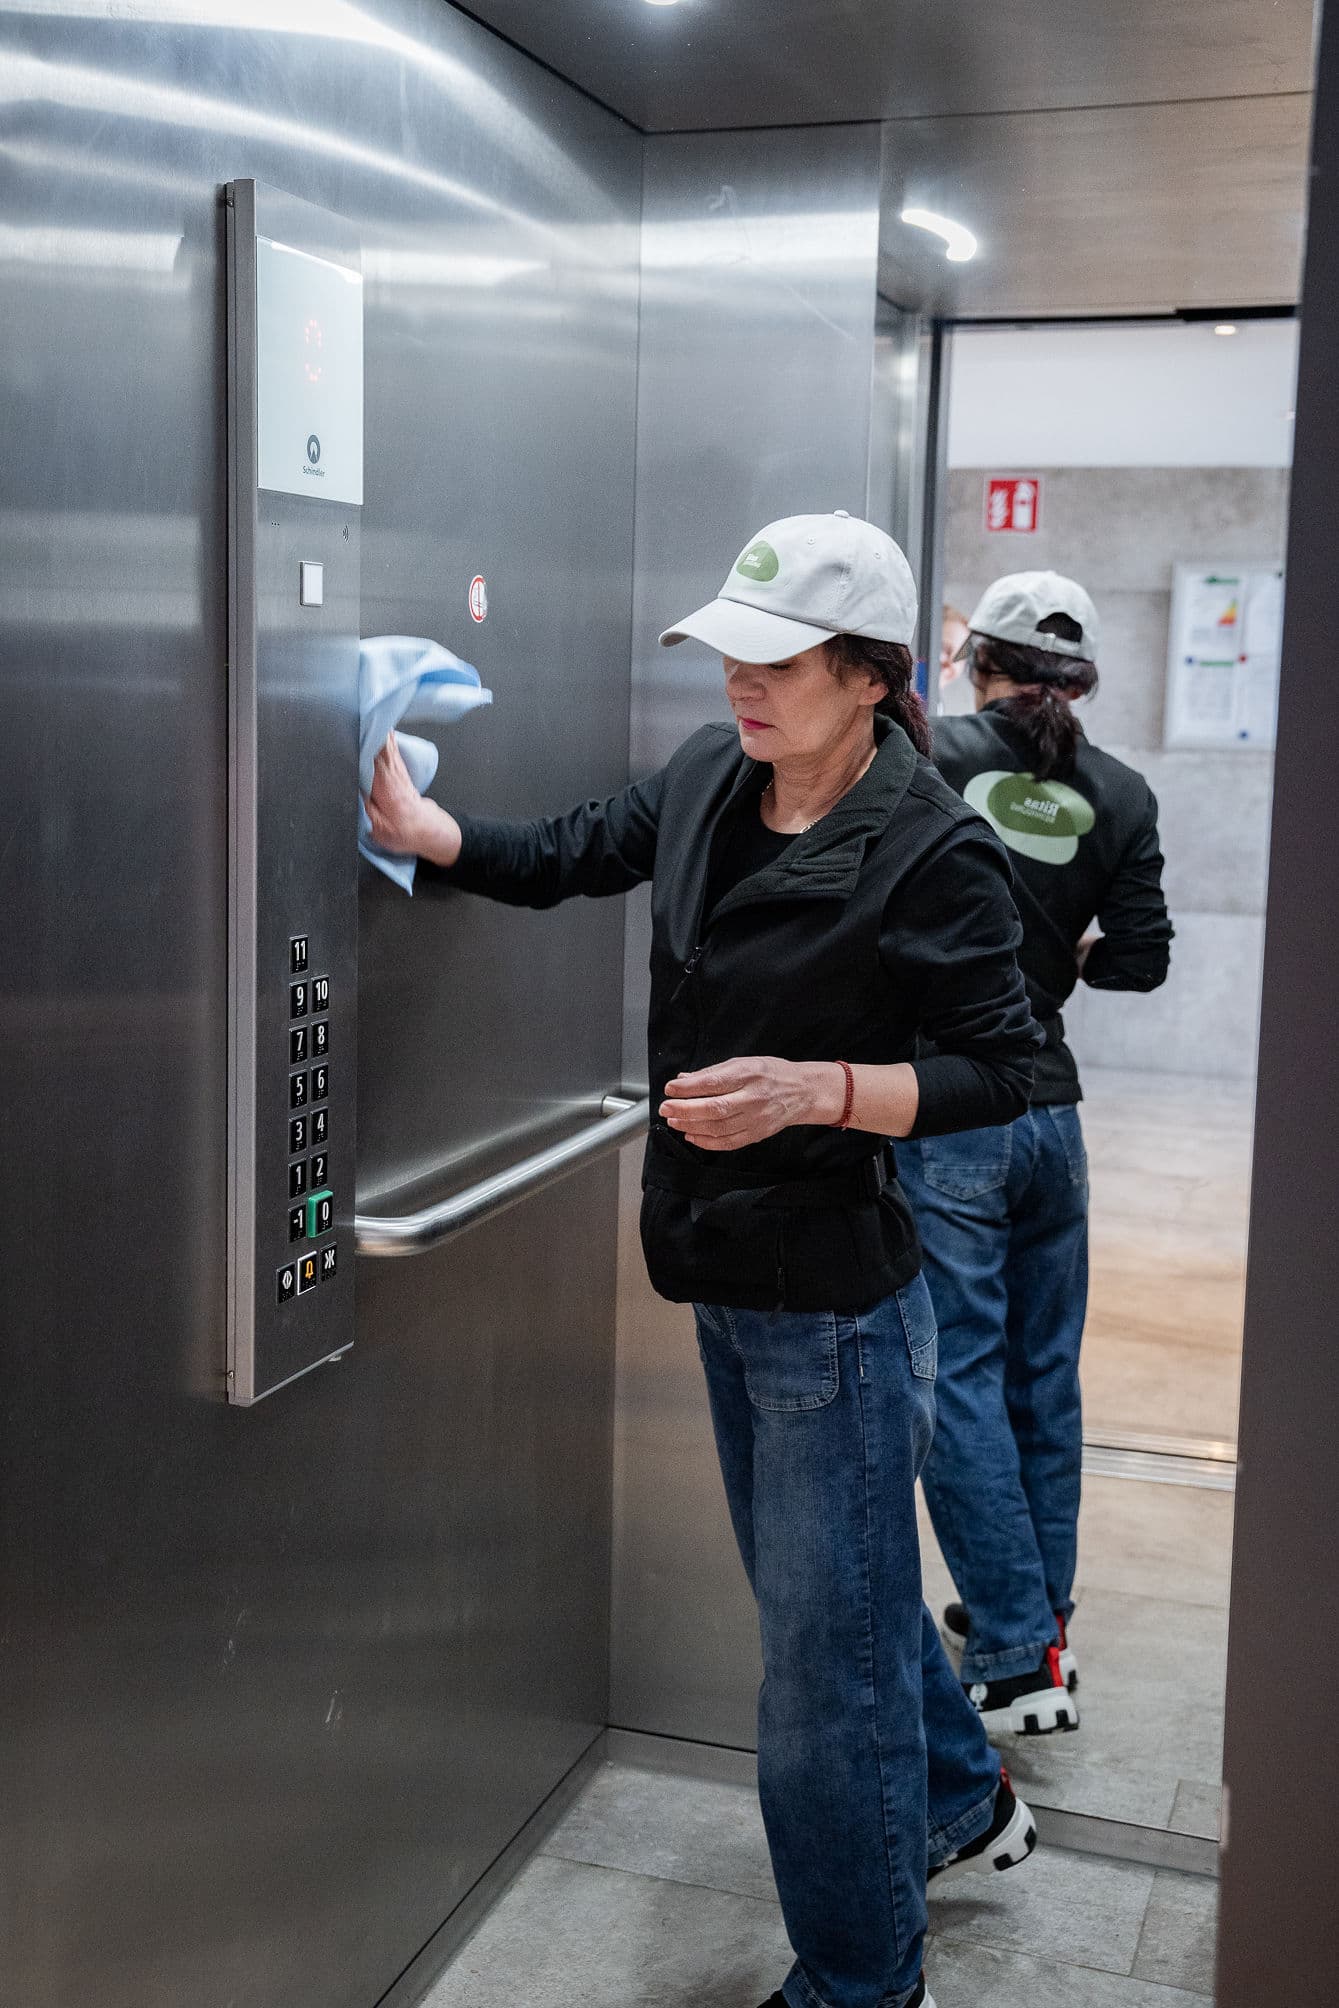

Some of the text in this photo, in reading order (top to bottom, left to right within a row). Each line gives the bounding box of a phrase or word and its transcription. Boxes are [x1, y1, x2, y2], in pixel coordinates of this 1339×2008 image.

[303, 465, 326, 477] Schindler
[294, 940, 306, 961] 11
[296, 986, 304, 1006] 9
[315, 980, 328, 1001] 10
[296, 1031, 304, 1051] 7
[317, 1025, 325, 1045] 8
[296, 1076, 303, 1097] 5
[317, 1069, 325, 1089] 6
[295, 1121, 303, 1141] 3
[316, 1112, 325, 1132] 4
[295, 1165, 302, 1185] 1
[316, 1157, 324, 1177] 2
[293, 1209, 303, 1229] -1
[321, 1201, 329, 1221] 0
